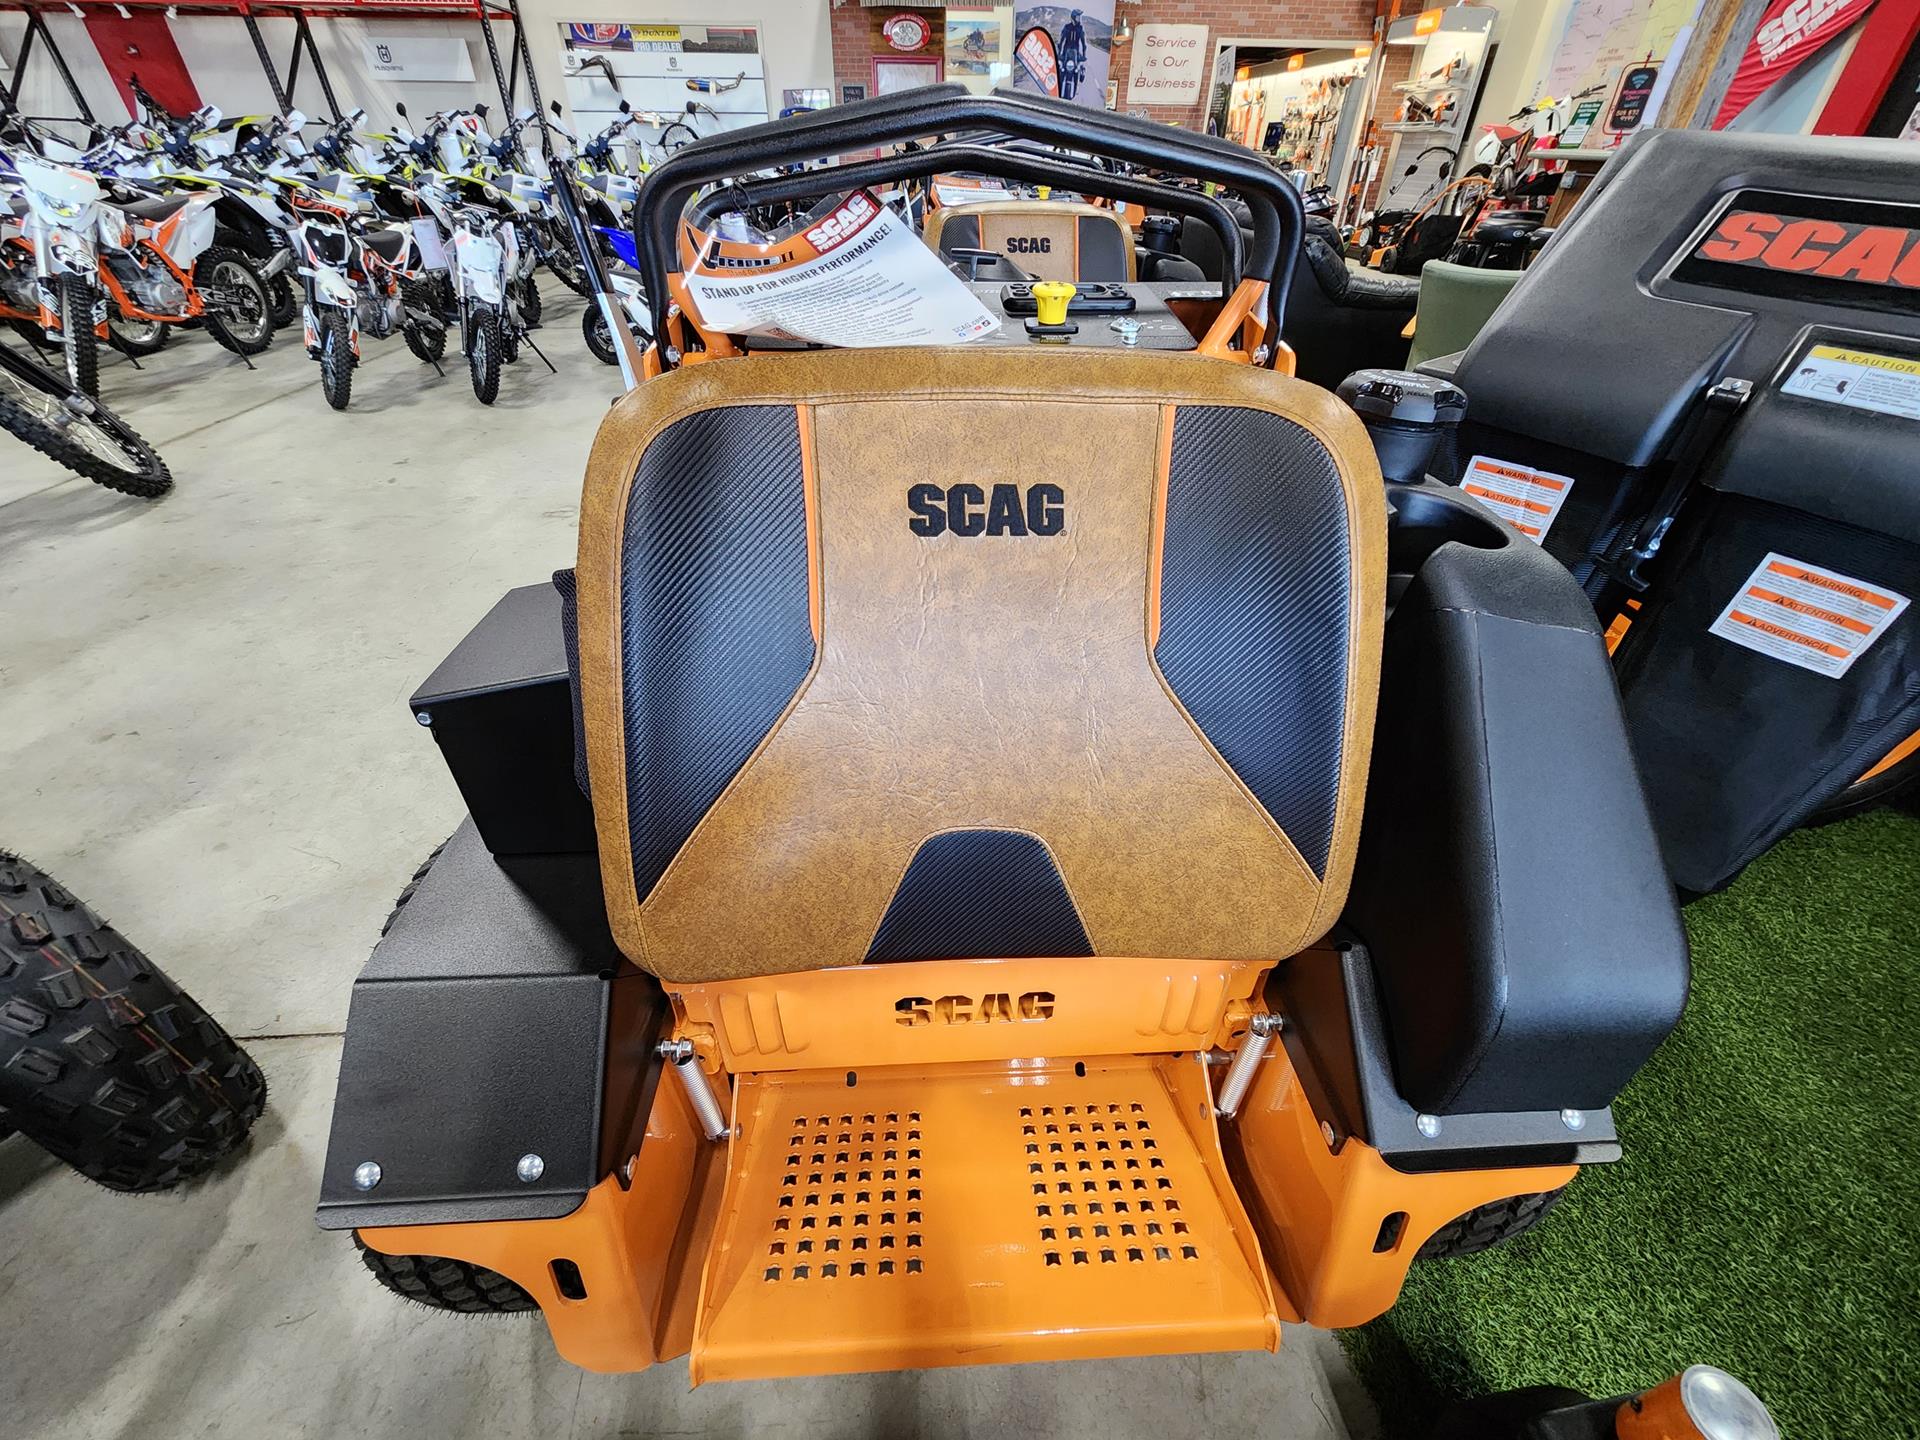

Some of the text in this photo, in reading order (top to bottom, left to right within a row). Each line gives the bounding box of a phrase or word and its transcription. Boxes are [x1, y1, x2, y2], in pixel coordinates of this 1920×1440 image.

[634, 41, 681, 52] PRO DEALER
[1145, 35, 1197, 48] Service
[1146, 56, 1189, 67] is Our
[1134, 77, 1196, 89] Business
[1546, 112, 1555, 132] 1
[806, 193, 869, 246] SCAG
[817, 205, 875, 253] POWER EQUIPMENT
[1007, 237, 1051, 253] SCAG
[702, 222, 894, 300] STAND UP FOR HIGHER PERFORMANCE!
[1851, 356, 1918, 373] CAUTION
[1504, 469, 1541, 485] WARNING
[906, 483, 1065, 537] SCAG
[1489, 491, 1533, 509] ATTENTION
[1812, 576, 1864, 598] WARNING
[1785, 600, 1846, 625] ATTENTION
[1756, 623, 1830, 652] ADVERTENCIA
[894, 991, 1056, 1027] SCAG
